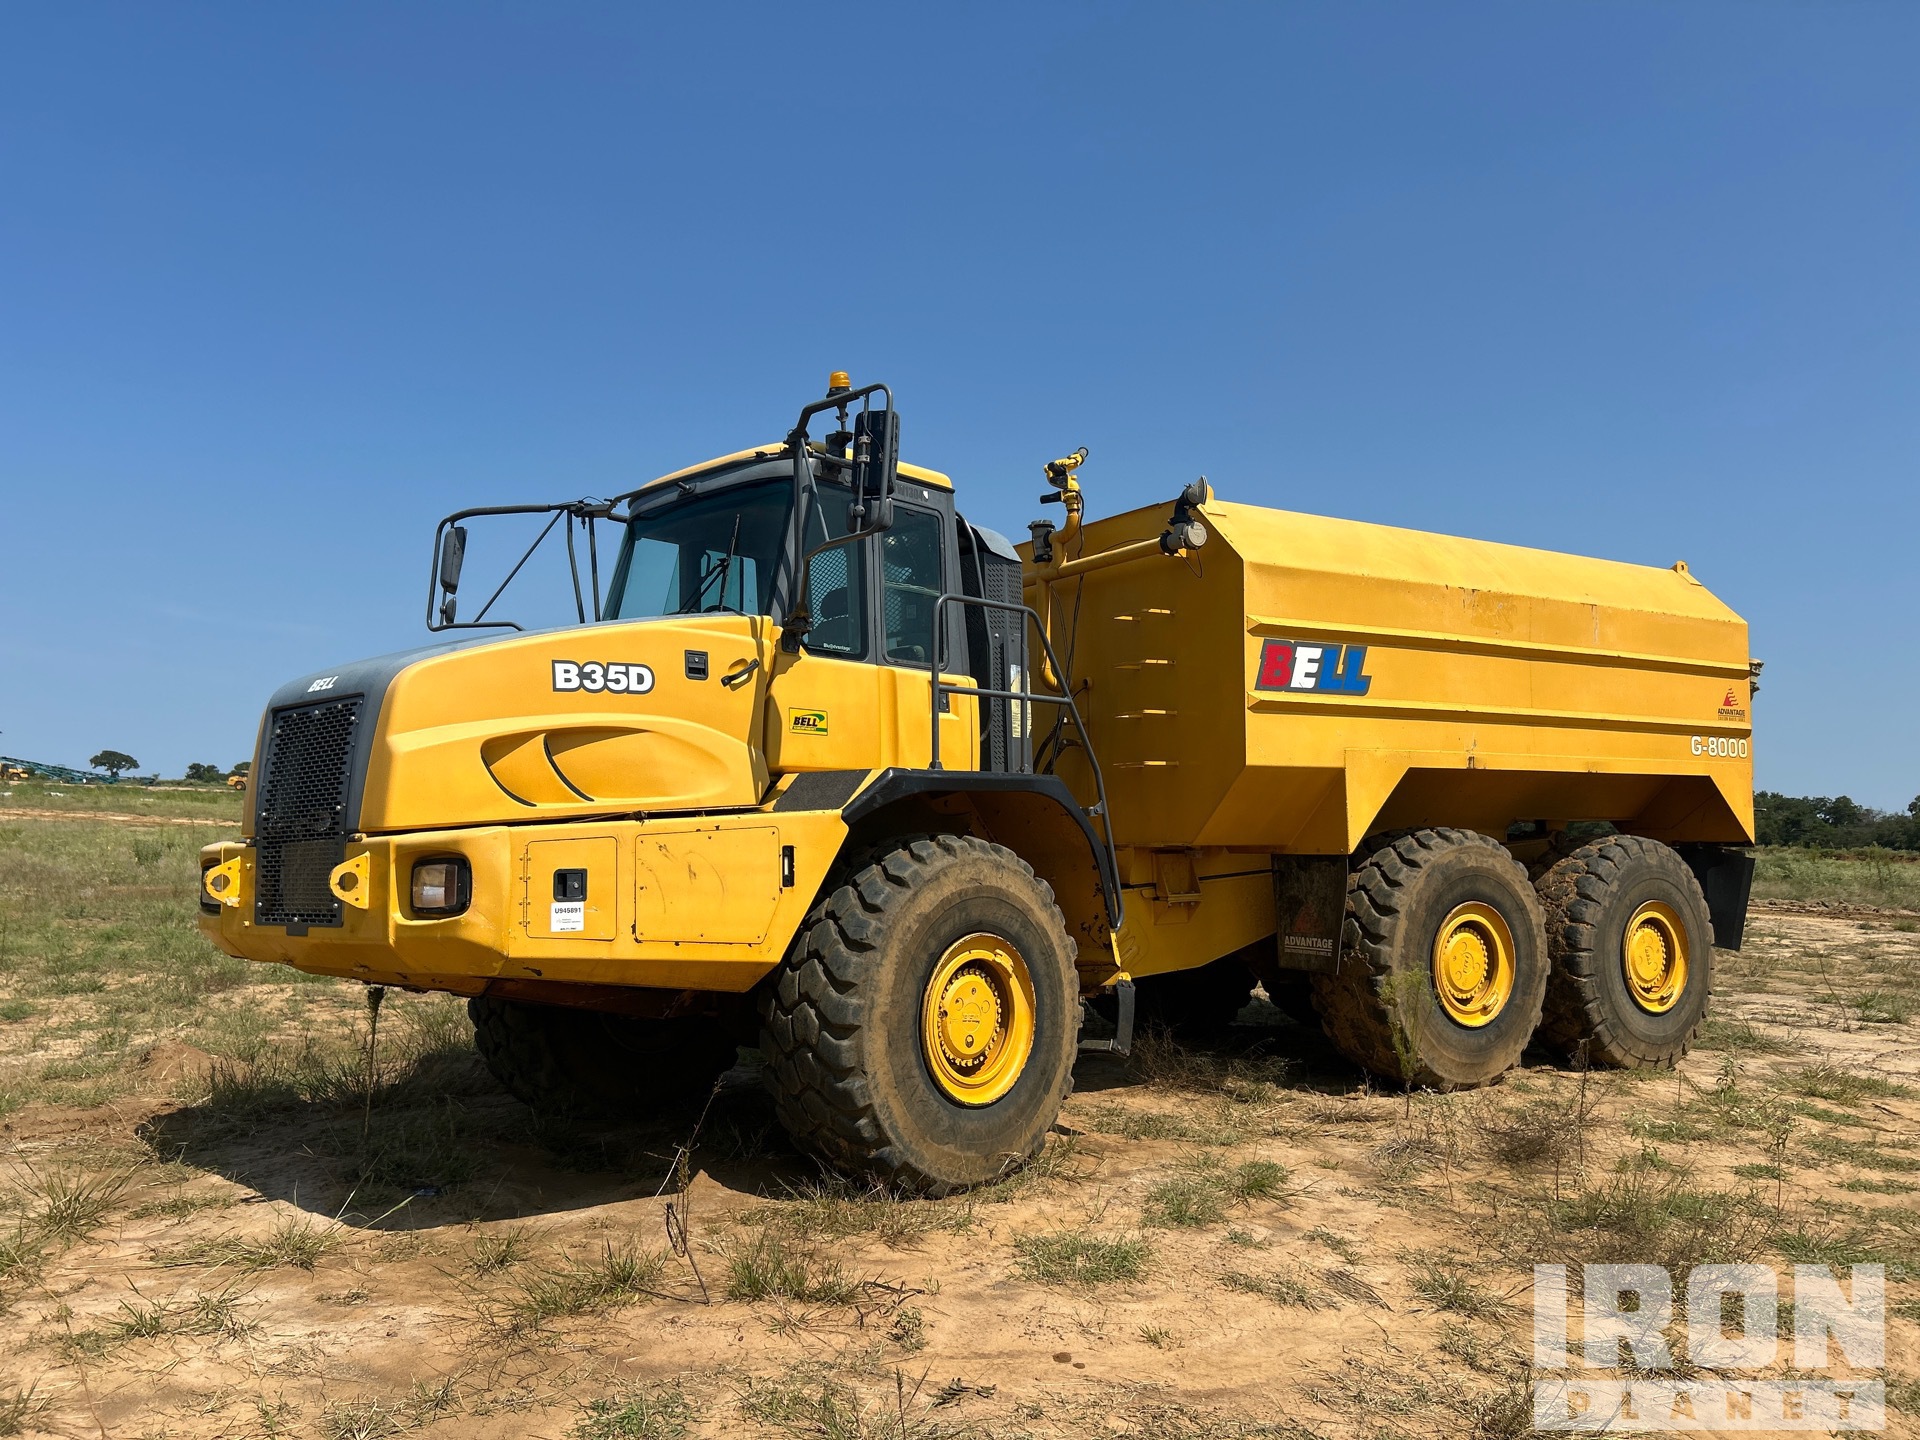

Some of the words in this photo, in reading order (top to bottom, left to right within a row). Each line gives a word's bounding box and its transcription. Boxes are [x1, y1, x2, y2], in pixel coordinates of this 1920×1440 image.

[1256, 640, 1371, 694] BELL
[307, 675, 339, 692] BELL
[553, 661, 654, 693] B35D
[1717, 708, 1746, 717] ADVANTAGE
[793, 716, 818, 727] BELL
[1691, 735, 1748, 758] G-8000
[1284, 935, 1333, 949] ADVANTAGE
